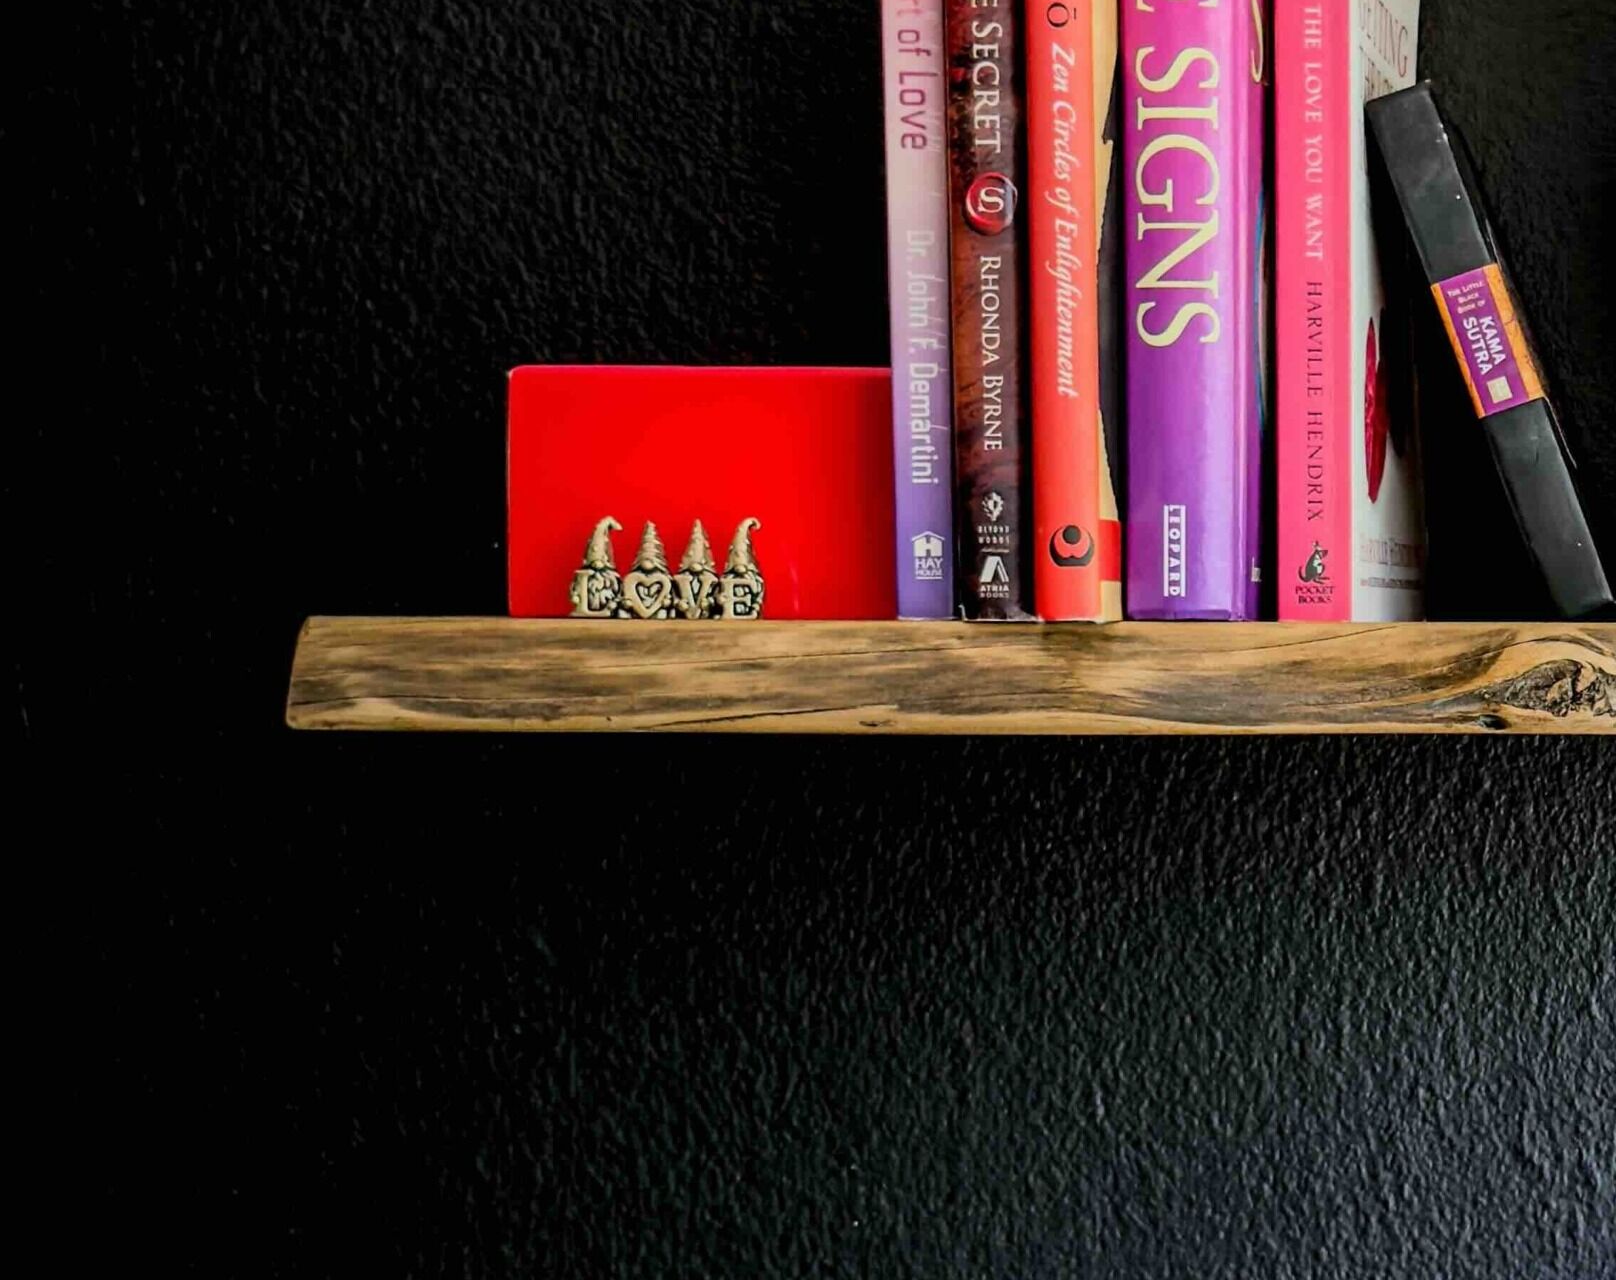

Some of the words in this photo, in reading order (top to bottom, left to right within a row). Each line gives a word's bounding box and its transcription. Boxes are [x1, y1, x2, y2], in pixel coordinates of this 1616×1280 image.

[897, 28, 932, 57] of
[1304, 6, 1323, 49] THE
[971, 21, 1002, 155] SECRET
[1051, 41, 1076, 93] Zen
[1304, 63, 1323, 123] LOVE
[898, 71, 939, 151] Love
[1052, 100, 1080, 179] Circles
[1304, 135, 1323, 184] YOU
[1044, 185, 1080, 217] of
[1134, 46, 1220, 347] SIGNS
[1305, 193, 1324, 260] WANT
[906, 230, 936, 260] Dr.
[907, 268, 938, 327] John
[979, 255, 1002, 367] RHONDA
[1045, 218, 1083, 397] Enlightenment
[1306, 281, 1323, 398] HARVILLE
[1463, 316, 1493, 375] SUTRA
[1479, 315, 1506, 365] KAMA
[909, 362, 940, 485] Demartini
[982, 374, 1004, 452] BYRNE
[1307, 411, 1324, 521] HENDRIX
[915, 558, 943, 569] HAY
[1168, 505, 1181, 596] LEOPARD
[1295, 585, 1335, 595] POCKET
